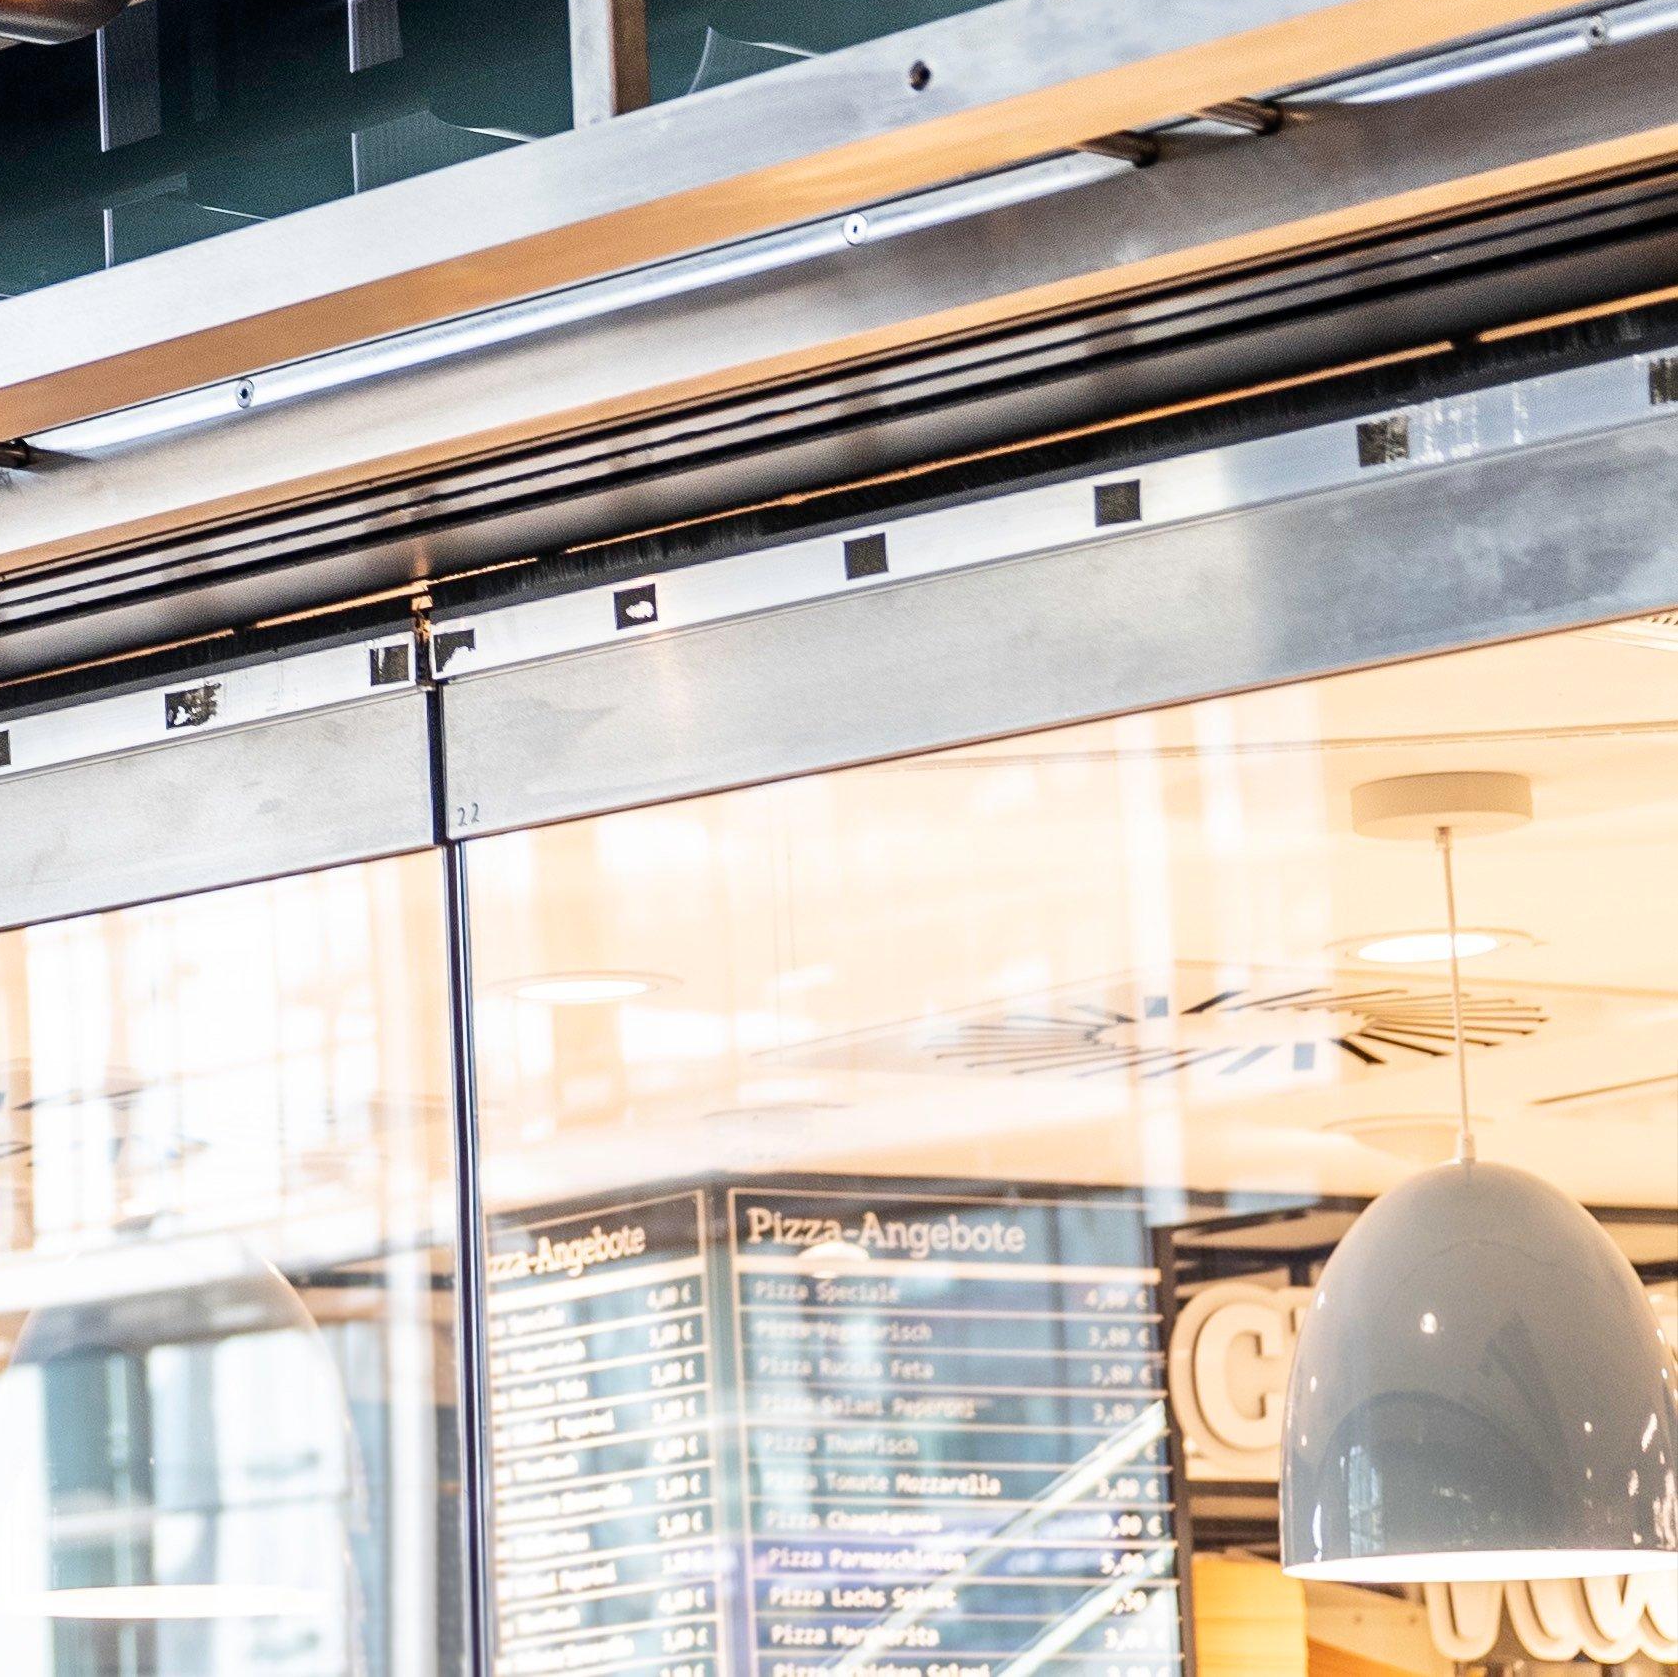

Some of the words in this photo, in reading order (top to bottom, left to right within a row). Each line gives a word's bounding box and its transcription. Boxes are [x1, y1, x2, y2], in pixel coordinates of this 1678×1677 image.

[456, 802, 480, 827] 22
[746, 1206, 1027, 1259] Pizza-Angebote
[487, 1224, 646, 1279] zza-Angebote
[754, 1279, 809, 1301] Pizza
[757, 1356, 813, 1376] Pizza
[889, 1358, 935, 1381] Feta
[823, 1434, 920, 1456] Thunfisch
[894, 1473, 1002, 1498] Mozzarella
[768, 1548, 824, 1569] Pizza
[769, 1585, 826, 1608] Pizza
[830, 1586, 887, 1609] Lachs
[891, 1587, 957, 1610] Spit
[771, 1623, 828, 1646] Pizza
[831, 1625, 941, 1648] Marrita
